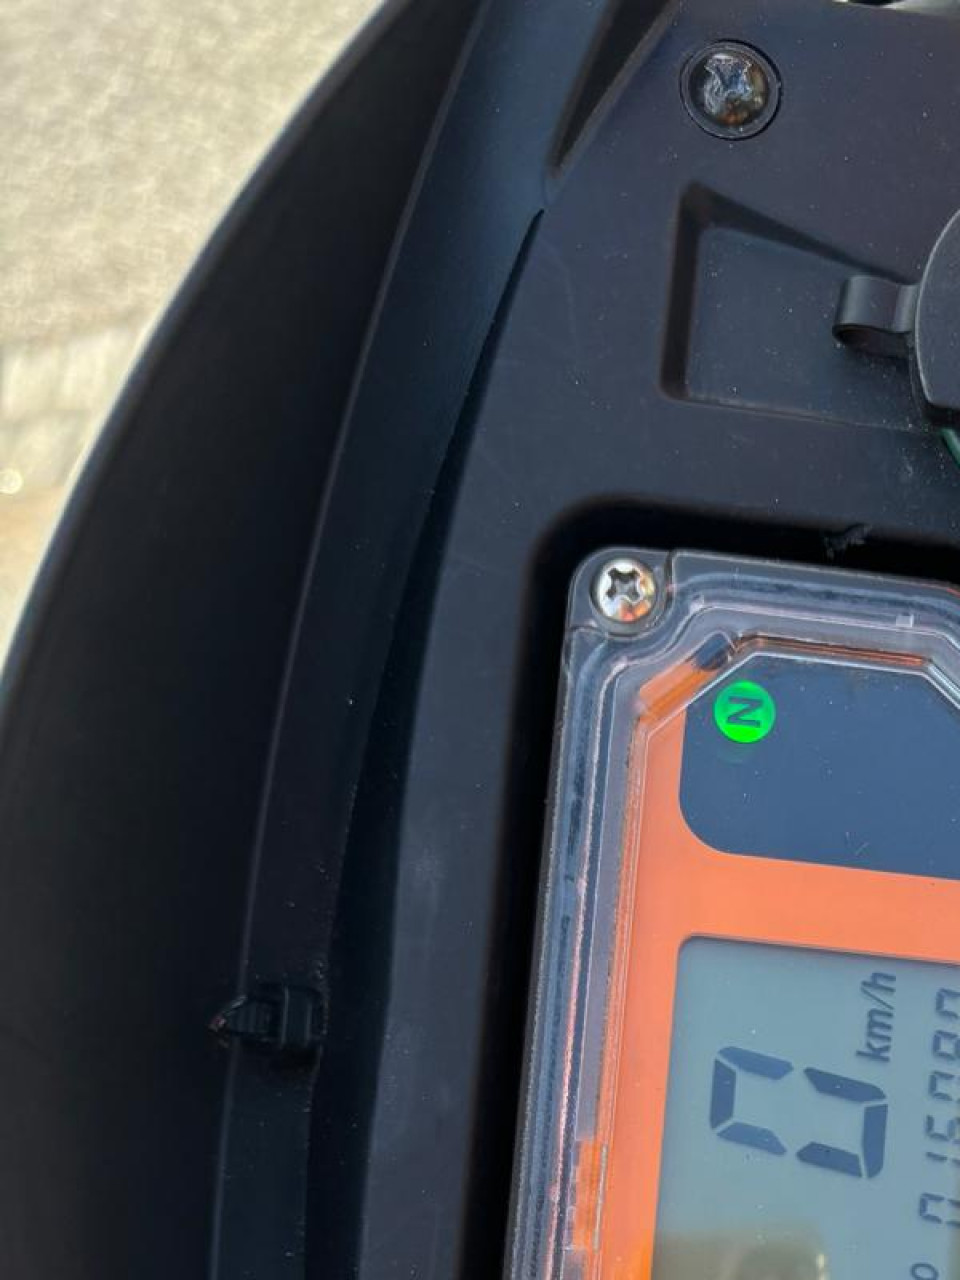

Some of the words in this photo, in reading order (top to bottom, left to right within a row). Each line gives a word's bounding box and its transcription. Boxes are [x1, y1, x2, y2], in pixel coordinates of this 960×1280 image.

[727, 696, 764, 728] N
[709, 1045, 889, 1180] 0
[856, 970, 897, 1063] km/h
